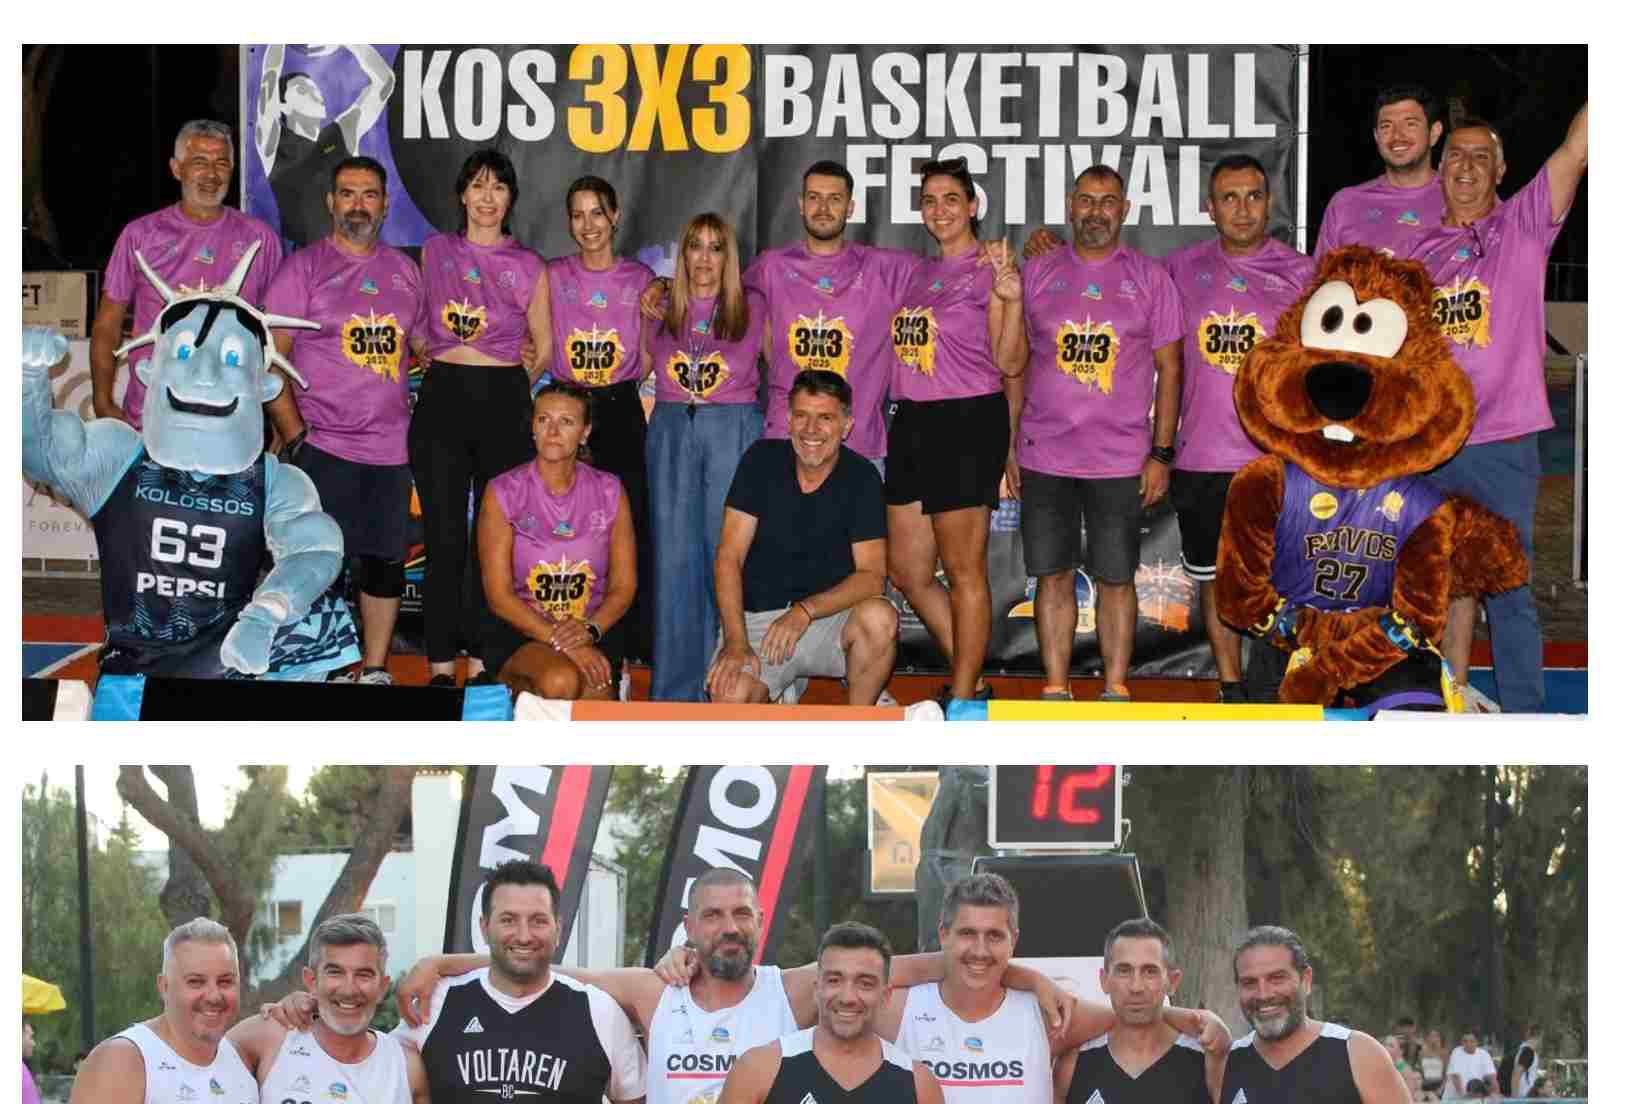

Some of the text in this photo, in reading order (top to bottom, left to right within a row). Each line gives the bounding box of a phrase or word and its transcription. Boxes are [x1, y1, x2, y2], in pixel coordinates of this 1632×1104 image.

[403, 44, 1276, 153] KOS 3X3 BASKETBALL
[1431, 290, 1481, 325] 3X3
[350, 325, 397, 353] 3X3
[795, 328, 842, 357] 3X3
[893, 316, 929, 347] 3X3
[1204, 323, 1256, 353] 3X3
[571, 340, 616, 370] 3X3
[1062, 333, 1110, 363] 3X3
[136, 485, 255, 516] KOLOSSOS
[150, 517, 227, 569] 63
[137, 572, 225, 599] PEPSI
[535, 573, 586, 602] 3X3
[1313, 559, 1368, 601] 27
[456, 1048, 568, 1092] VOLTAREN
